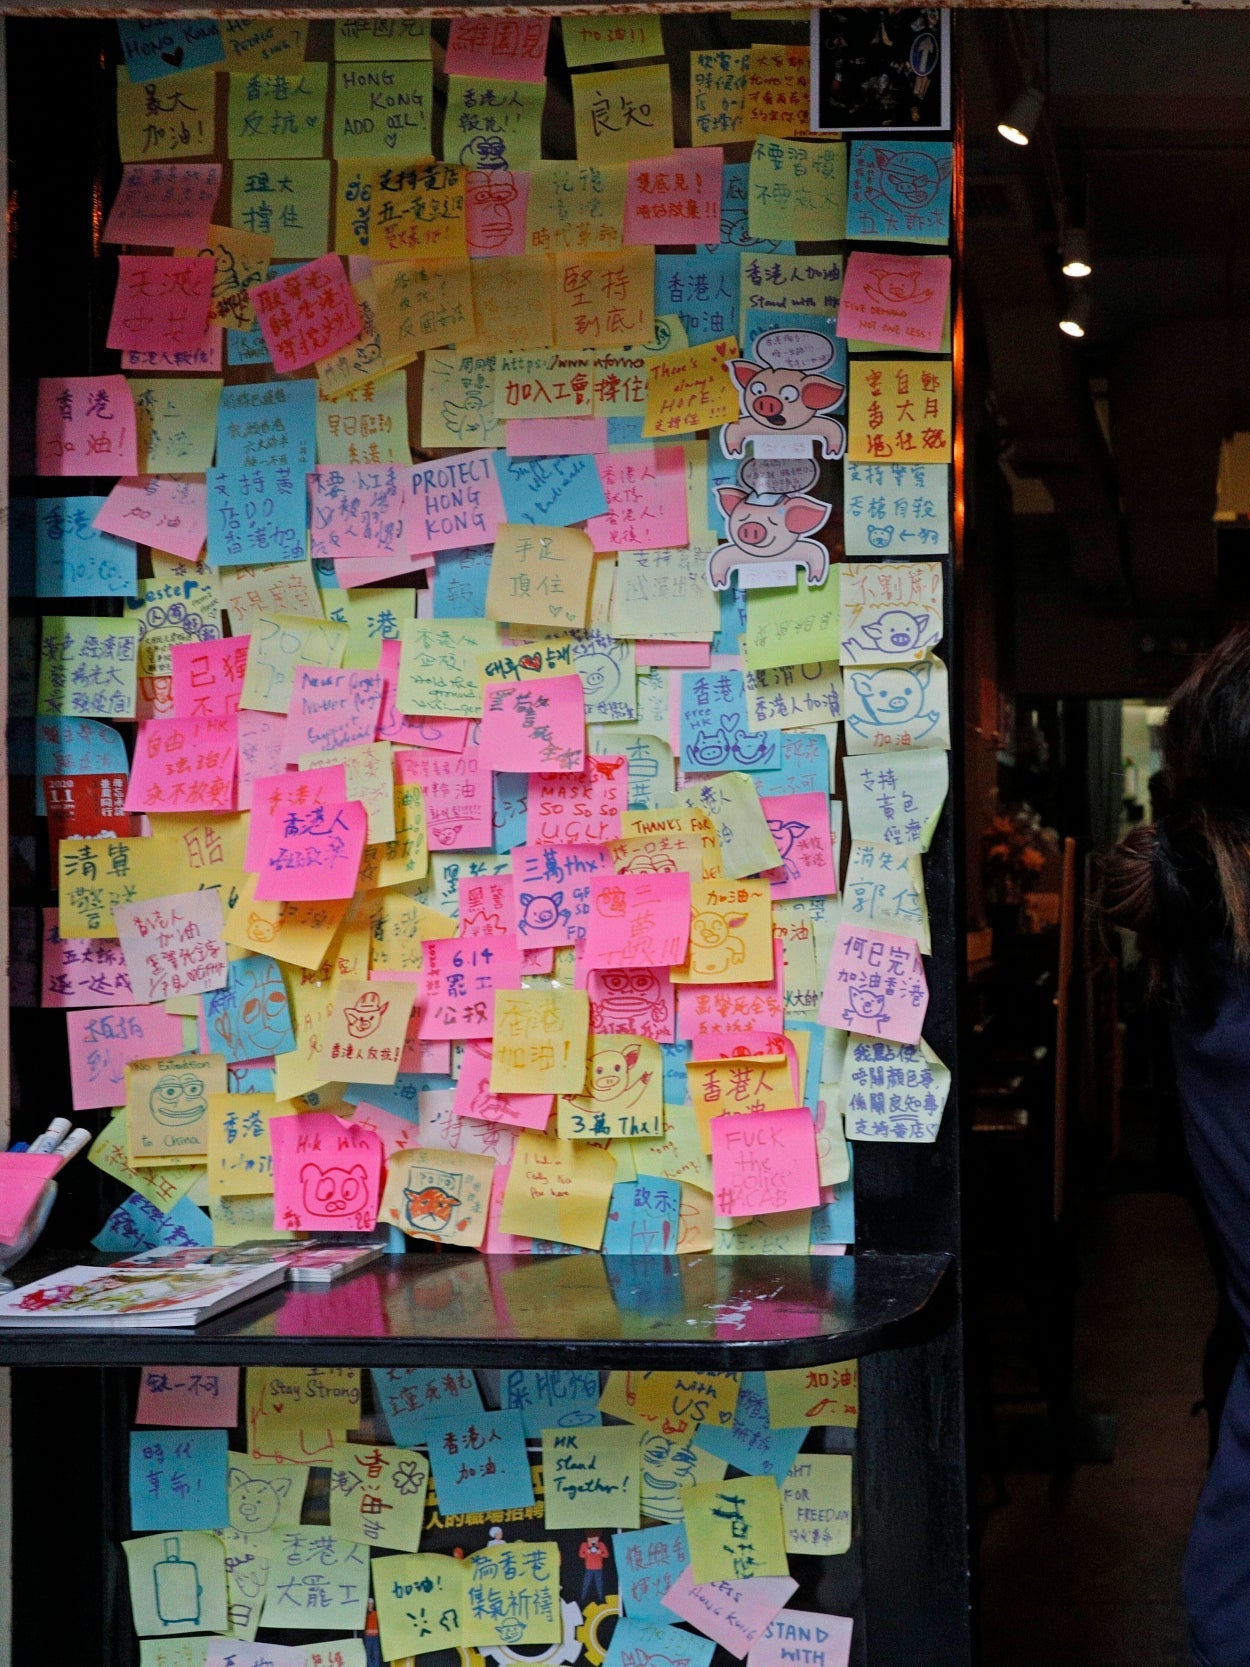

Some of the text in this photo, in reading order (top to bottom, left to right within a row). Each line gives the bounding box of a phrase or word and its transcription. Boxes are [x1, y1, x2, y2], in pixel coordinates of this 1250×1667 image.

[246, 75, 312, 101] 香港人
[343, 71, 396, 88] HONG
[370, 89, 423, 111] KONG
[240, 110, 299, 138] 反抗
[344, 111, 427, 135] ADD OIL!
[592, 90, 653, 137] 良知
[244, 171, 295, 194] 理大
[564, 265, 630, 307] 堅持
[668, 271, 732, 304] 香港人
[574, 308, 644, 337] 到底!
[56, 389, 115, 420] 香港
[412, 458, 490, 495] PROTECT
[425, 486, 481, 516] HONG
[424, 507, 487, 541] KONG
[515, 537, 565, 563] 手足
[509, 572, 565, 598] 頂住
[873, 732, 911, 747] 加油
[541, 786, 617, 800] MASK IS
[284, 806, 349, 838] 香港人
[539, 803, 618, 818] SO SO SO
[541, 821, 609, 839] UGLY
[567, 926, 586, 939] FD
[452, 948, 494, 968] 6.14
[702, 1069, 774, 1103] 香港人
[725, 1127, 785, 1150] FUCK
[269, 1378, 302, 1402] Stay
[306, 1380, 361, 1404] Strong
[674, 1379, 718, 1398] with
[672, 1395, 710, 1422] US
[442, 1424, 502, 1455] 香港人
[554, 1435, 578, 1449] HK
[784, 1489, 810, 1502] FOR
[282, 1533, 365, 1566] 香港人
[469, 1549, 550, 1582] 為香港
[277, 1574, 361, 1609] 大罷工
[392, 1575, 444, 1599] 加油!
[468, 1585, 555, 1623] 集氣祈禱
[765, 1620, 829, 1645] STAND
[780, 1648, 825, 1663] WITH
